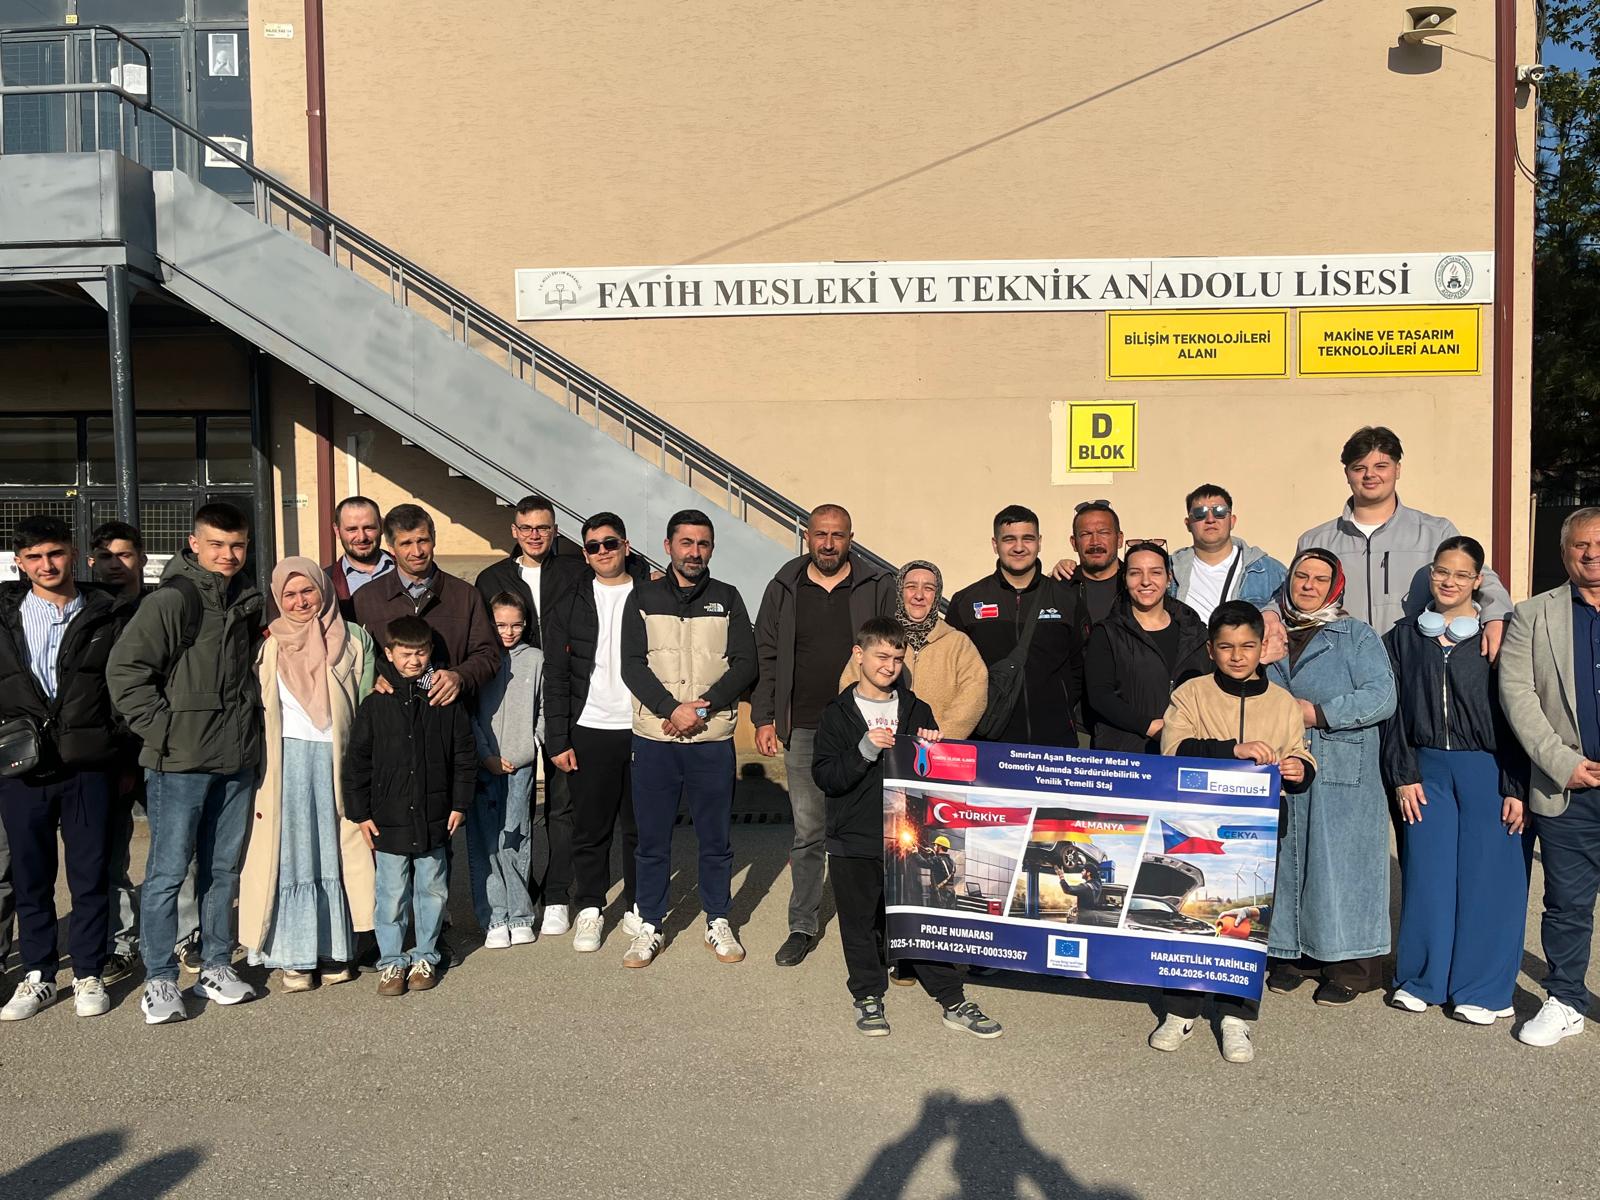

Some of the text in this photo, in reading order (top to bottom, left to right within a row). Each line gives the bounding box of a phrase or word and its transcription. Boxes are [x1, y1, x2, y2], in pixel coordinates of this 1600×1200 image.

[597, 274, 703, 308] FATİH
[714, 271, 879, 305] MESLEKİ
[889, 276, 937, 303] VE
[948, 268, 1092, 302] TEKNİK
[1100, 271, 1282, 300] ANADOLU
[1295, 262, 1411, 297] LİSESİ
[1124, 330, 1271, 346] BİLİŞİM TEKNOLOJİLERİ
[1324, 328, 1454, 342] MAKİNE VE TASARIM
[1178, 348, 1217, 359] ALANI
[1318, 342, 1460, 356] TEKNOLOJİLERİ ALANI
[1092, 413, 1112, 438] D
[1079, 445, 1125, 460] BLOK
[1010, 750, 1041, 760] Sınırları
[1043, 753, 1064, 763] Aşan
[1066, 754, 1103, 765] Beceriler
[1105, 757, 1129, 767] Metal
[998, 761, 1152, 781] Otomotiv Alanında Sürdürülebilirlik ve
[1035, 776, 1113, 791] Yenilik Temelli Staj
[1209, 781, 1267, 795] Erasmus+
[958, 809, 1006, 823] TÜRKİYE
[1073, 819, 1126, 832] ALMANYA
[920, 923, 994, 941] PROJE NUMARASI
[890, 938, 1028, 961] 2025-1-TR01-KA122-VET-000339367
[1150, 951, 1258, 973] HARAKETLİLİK TARİHLERİ
[1158, 966, 1249, 986] 26.04.2026-16.05.2026
